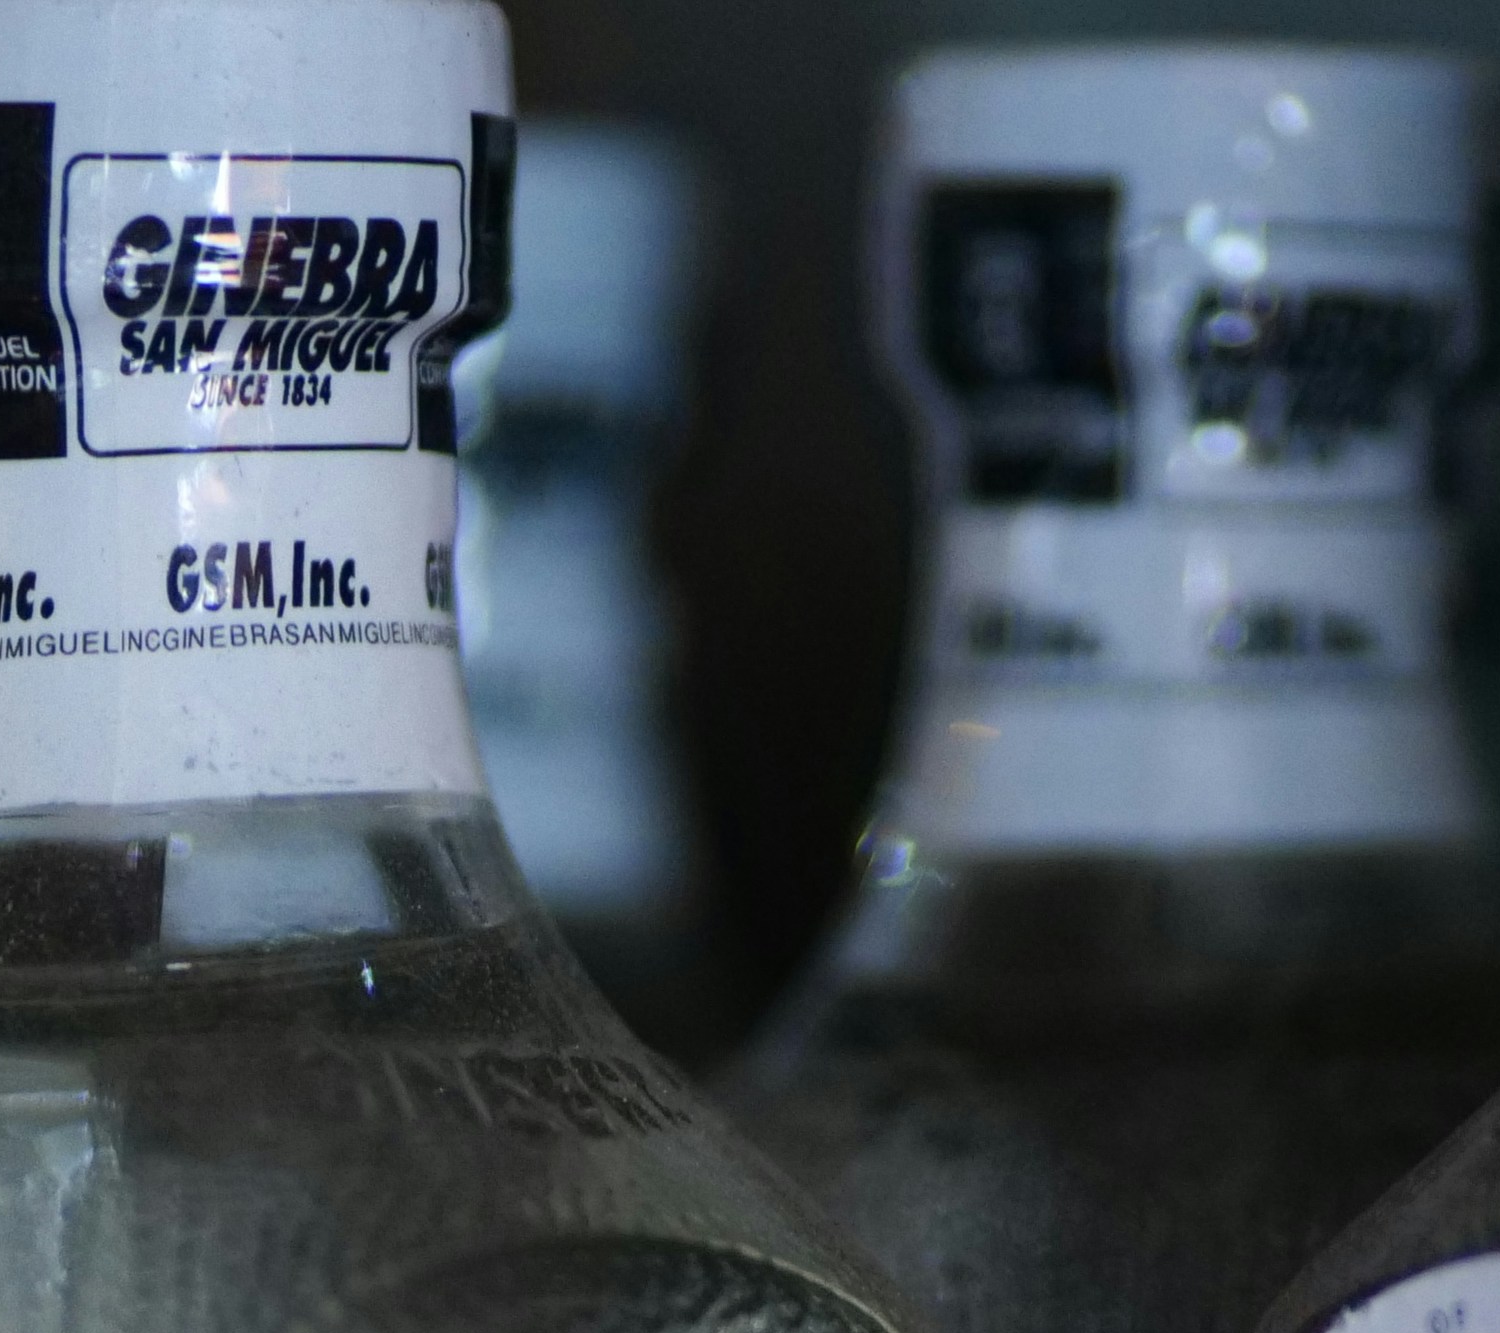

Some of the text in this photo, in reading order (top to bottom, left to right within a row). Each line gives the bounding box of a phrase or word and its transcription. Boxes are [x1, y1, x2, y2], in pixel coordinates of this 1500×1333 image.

[102, 214, 438, 319] GINEBRA
[119, 319, 226, 375] SAN
[232, 319, 408, 373] MIGUEL
[189, 374, 332, 407] SINCE 1834
[166, 540, 370, 618] GSM,Inc.
